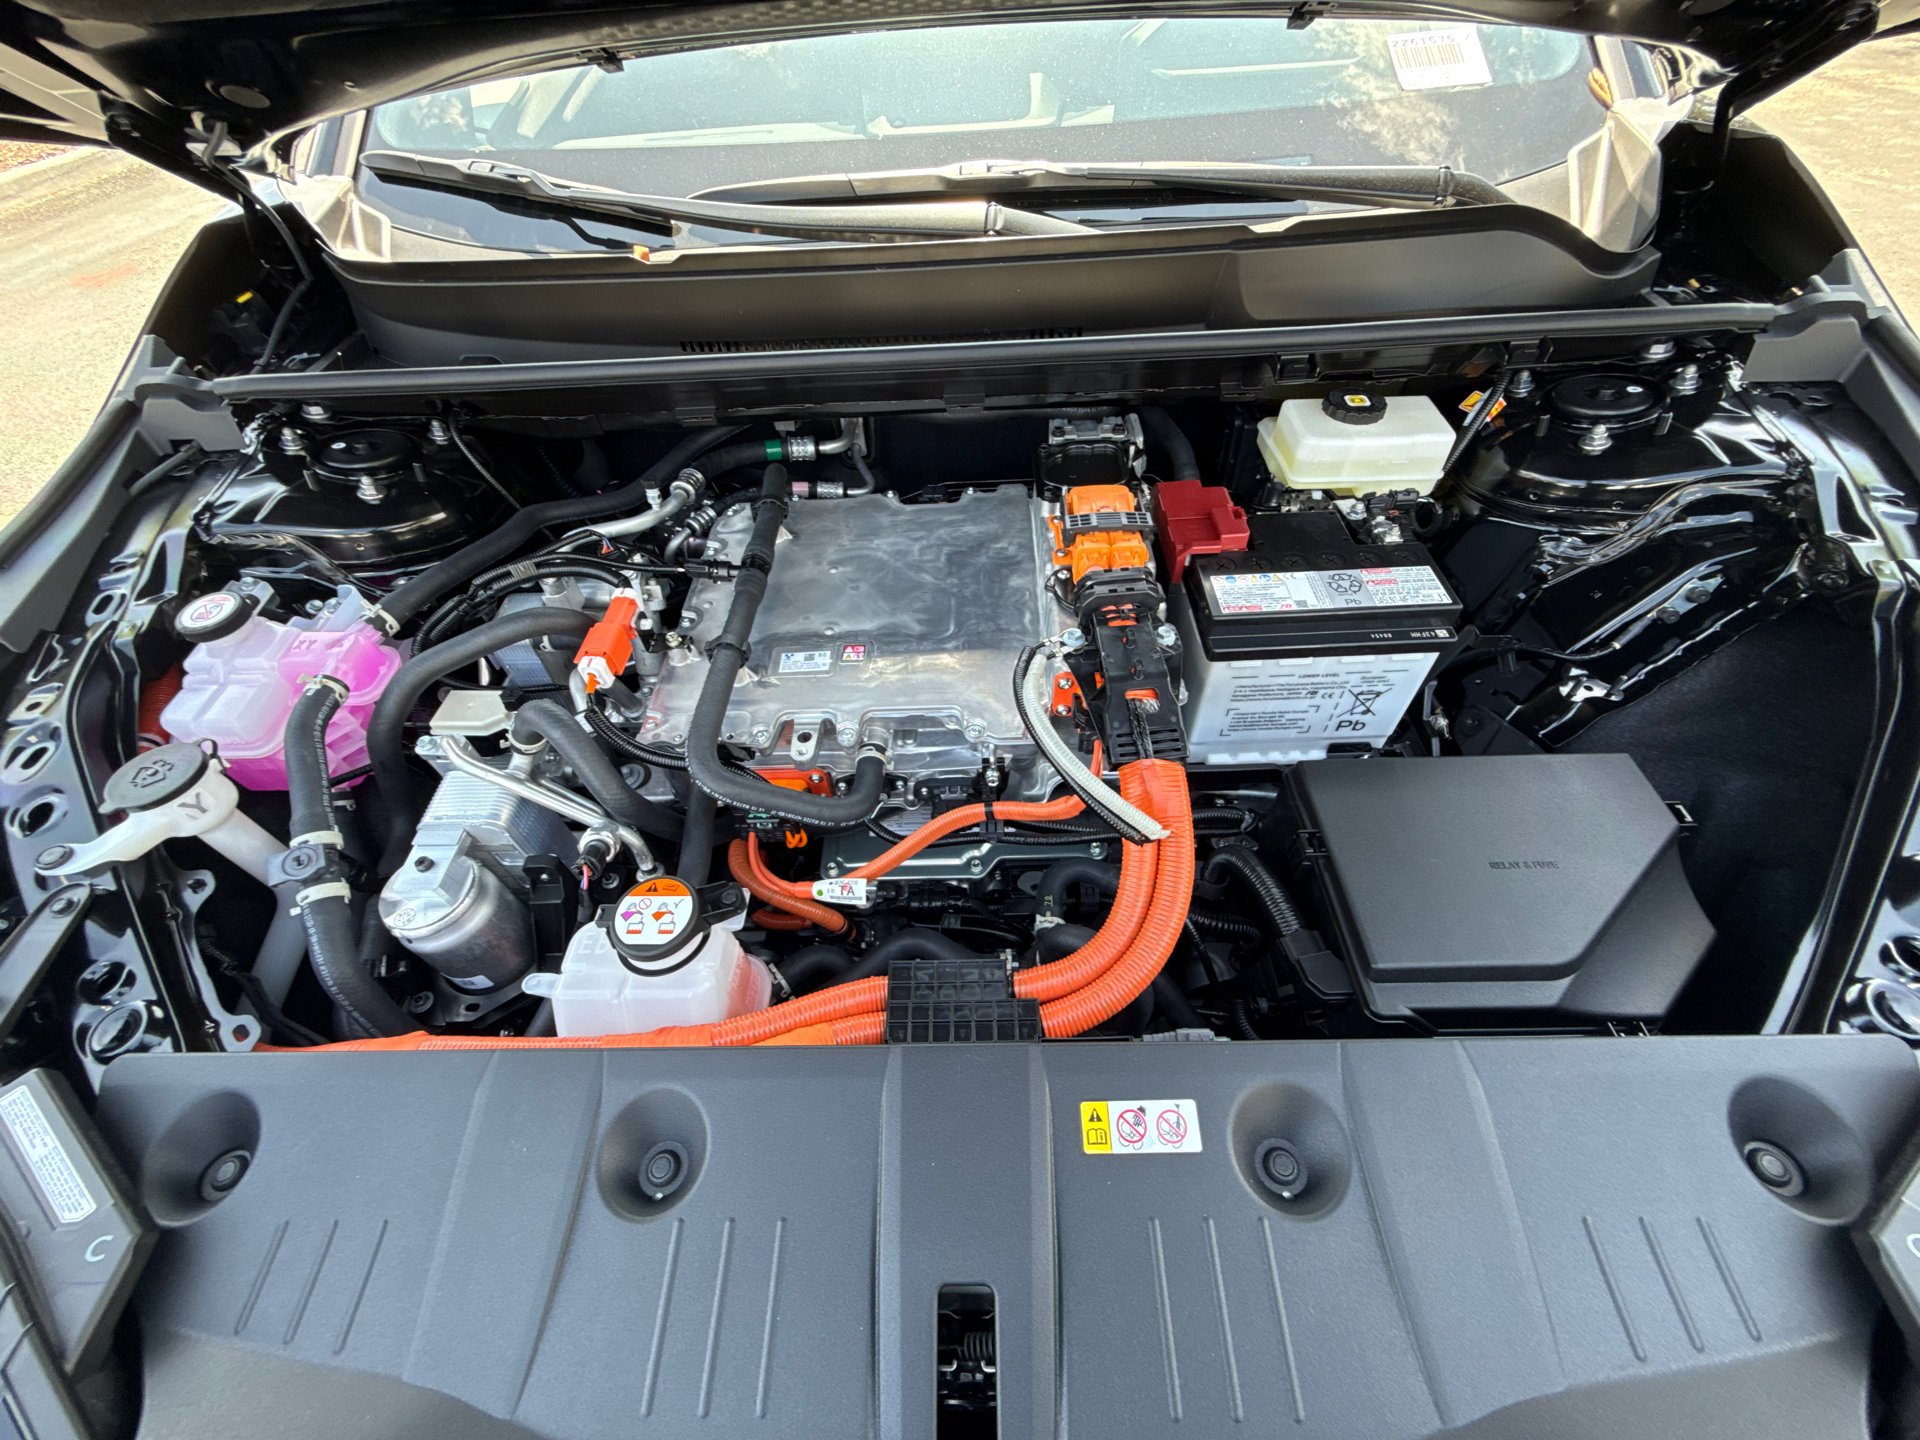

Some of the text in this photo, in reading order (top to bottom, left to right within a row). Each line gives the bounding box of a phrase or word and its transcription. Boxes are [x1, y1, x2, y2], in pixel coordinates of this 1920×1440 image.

[1345, 598, 1362, 606] Pb
[1335, 719, 1366, 732] Pb
[1488, 861, 1560, 869] RELAY & FUSE
